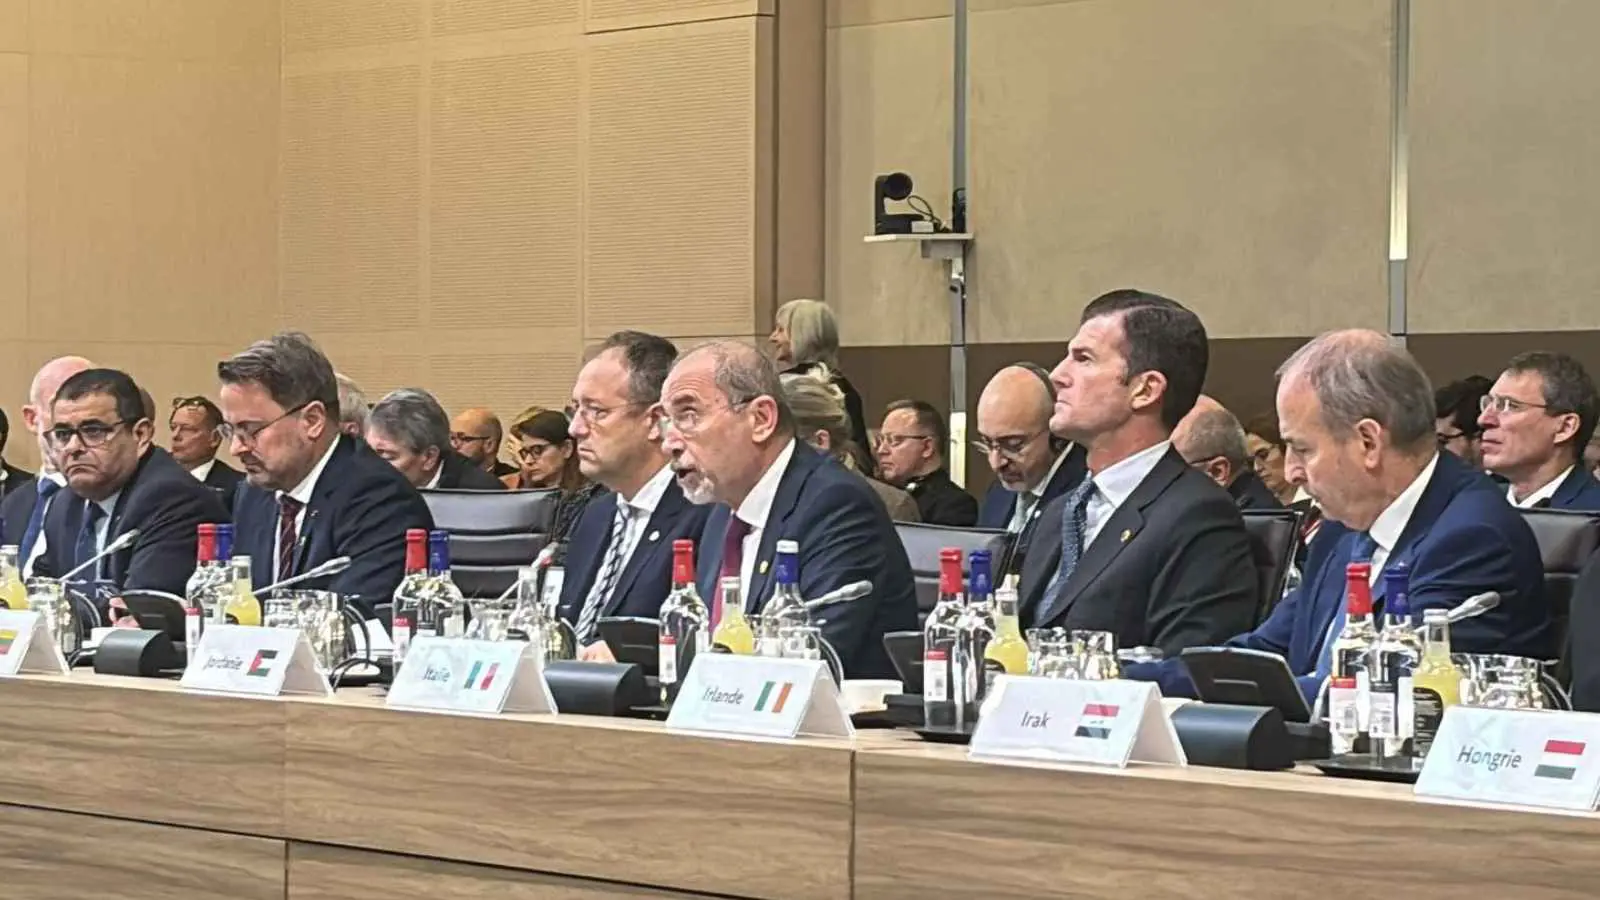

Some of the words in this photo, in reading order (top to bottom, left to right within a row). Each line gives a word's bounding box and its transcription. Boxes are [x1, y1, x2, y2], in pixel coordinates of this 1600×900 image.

[702, 686, 744, 704] Irlande
[1021, 710, 1051, 728] Irak
[1457, 745, 1522, 771] Hongrie
